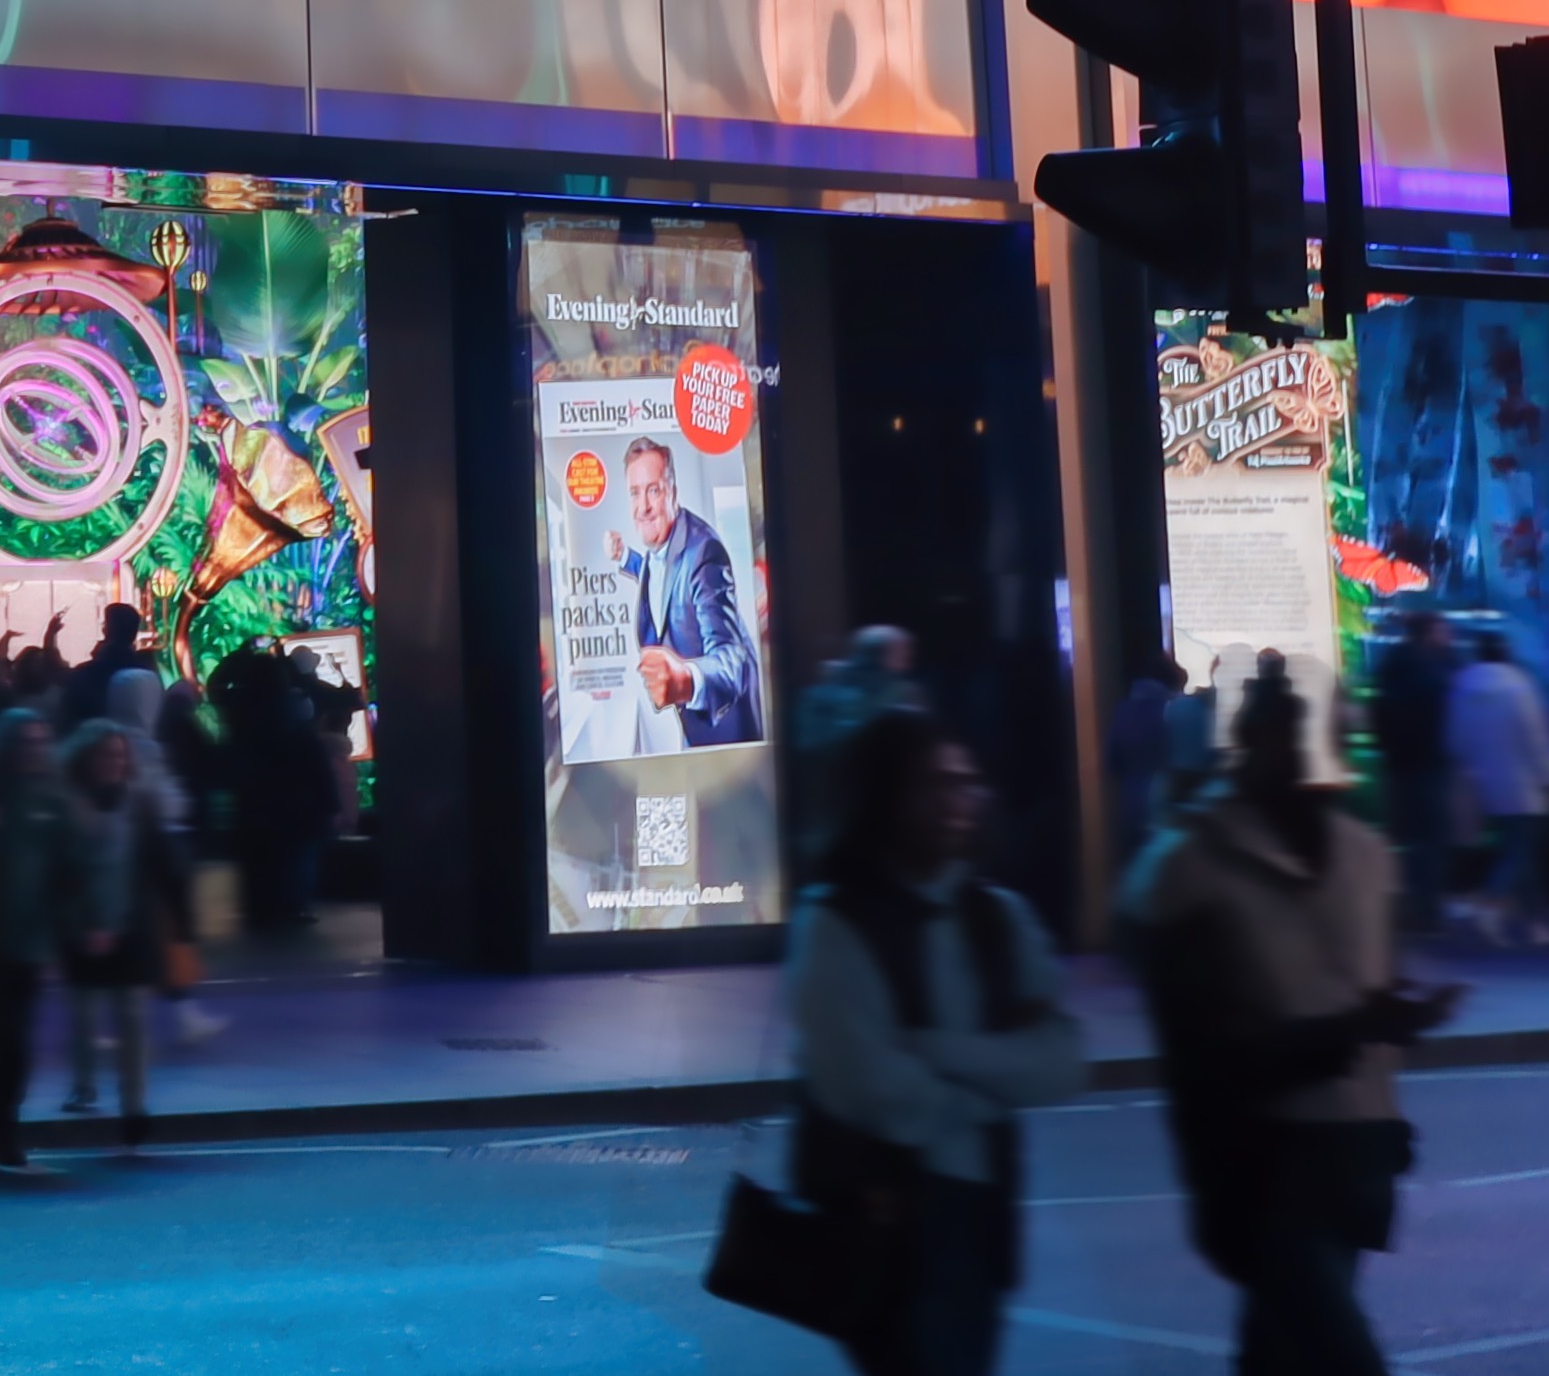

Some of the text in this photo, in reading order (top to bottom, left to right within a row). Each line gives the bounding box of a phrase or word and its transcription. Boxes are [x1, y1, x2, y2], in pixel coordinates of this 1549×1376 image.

[546, 292, 739, 330] Evening Standard
[681, 373, 747, 410] YOUR FREE
[692, 361, 738, 389] PICK UP
[559, 401, 628, 427] Evening
[691, 395, 732, 420] PAPER
[1160, 352, 1309, 449] BUTTERFLY
[690, 410, 731, 436] TODAY
[1206, 402, 1283, 461] TRAIL
[570, 566, 617, 596] Piers
[561, 597, 631, 635] packs a
[568, 627, 627, 666] punch
